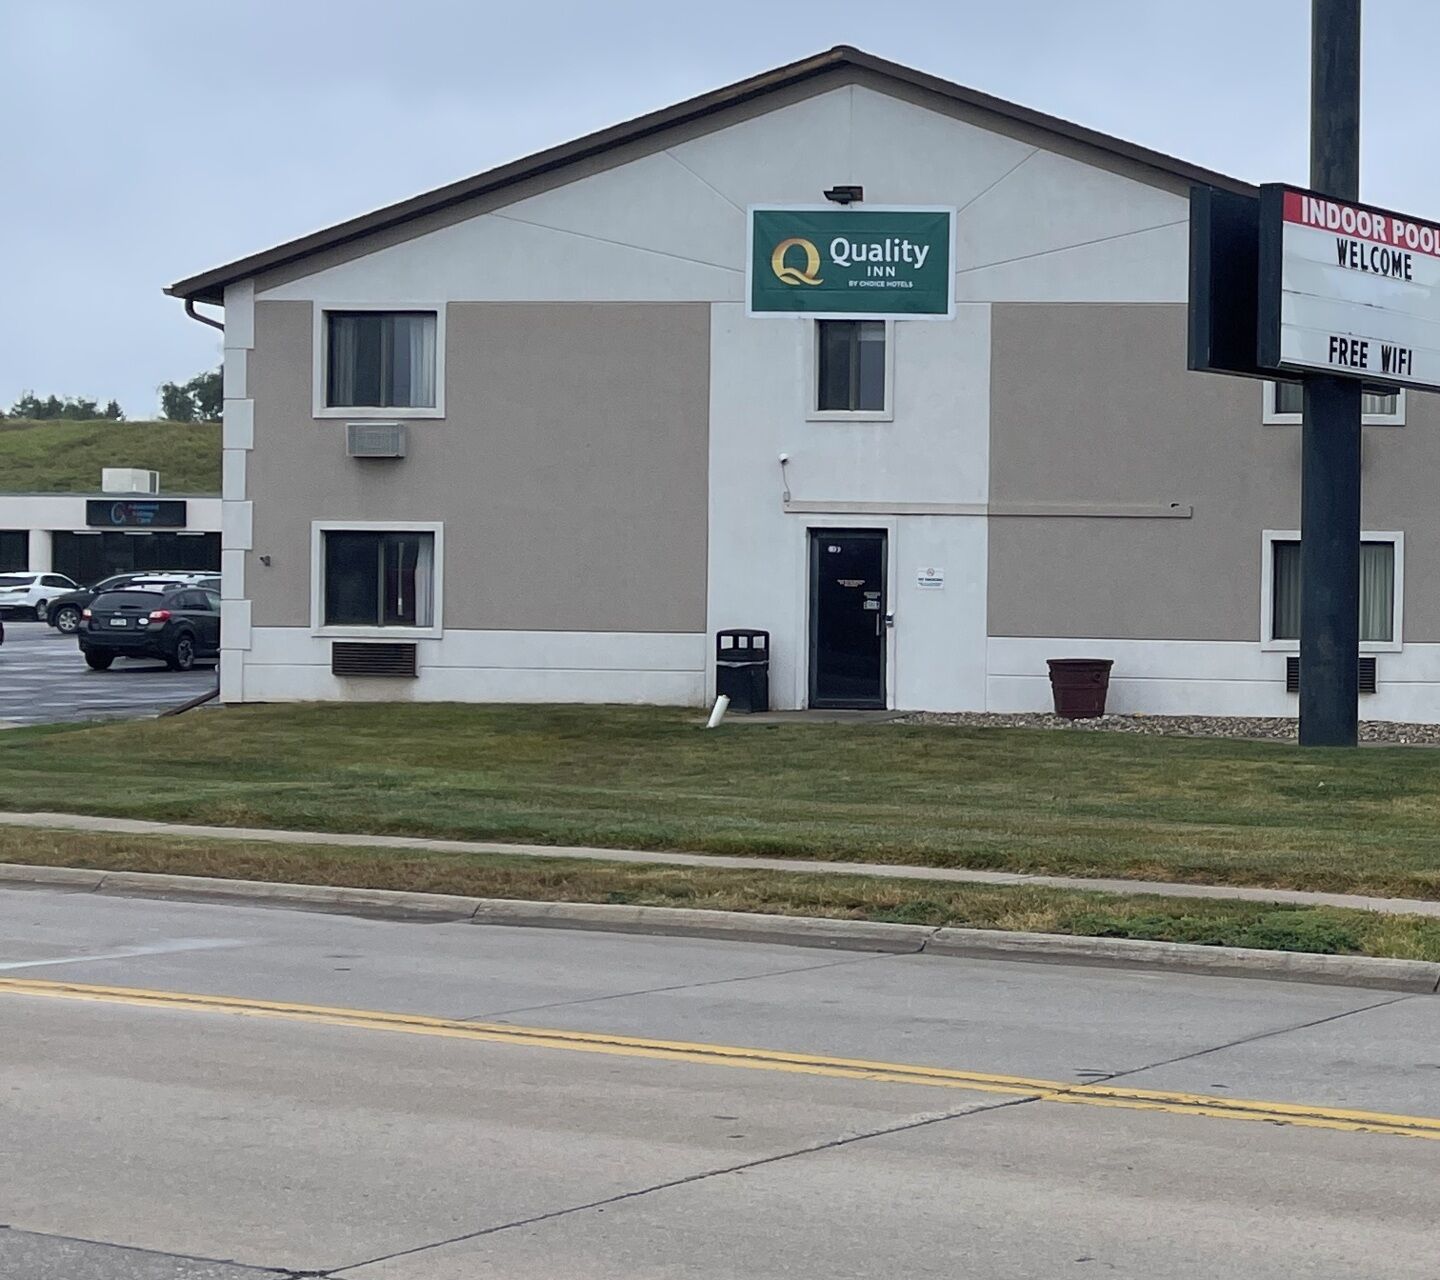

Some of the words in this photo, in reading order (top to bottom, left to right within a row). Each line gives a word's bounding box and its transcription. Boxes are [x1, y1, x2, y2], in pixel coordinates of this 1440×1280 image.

[1301, 195, 1387, 241] INDOOR
[771, 237, 824, 286] Q
[829, 237, 930, 269] Quality
[867, 266, 896, 277] INN
[1336, 237, 1412, 280] WELCOME
[859, 280, 885, 288] CHOICE
[886, 280, 914, 289] HOTELS
[1329, 336, 1368, 368] FREE
[1381, 344, 1412, 375] WIFI
